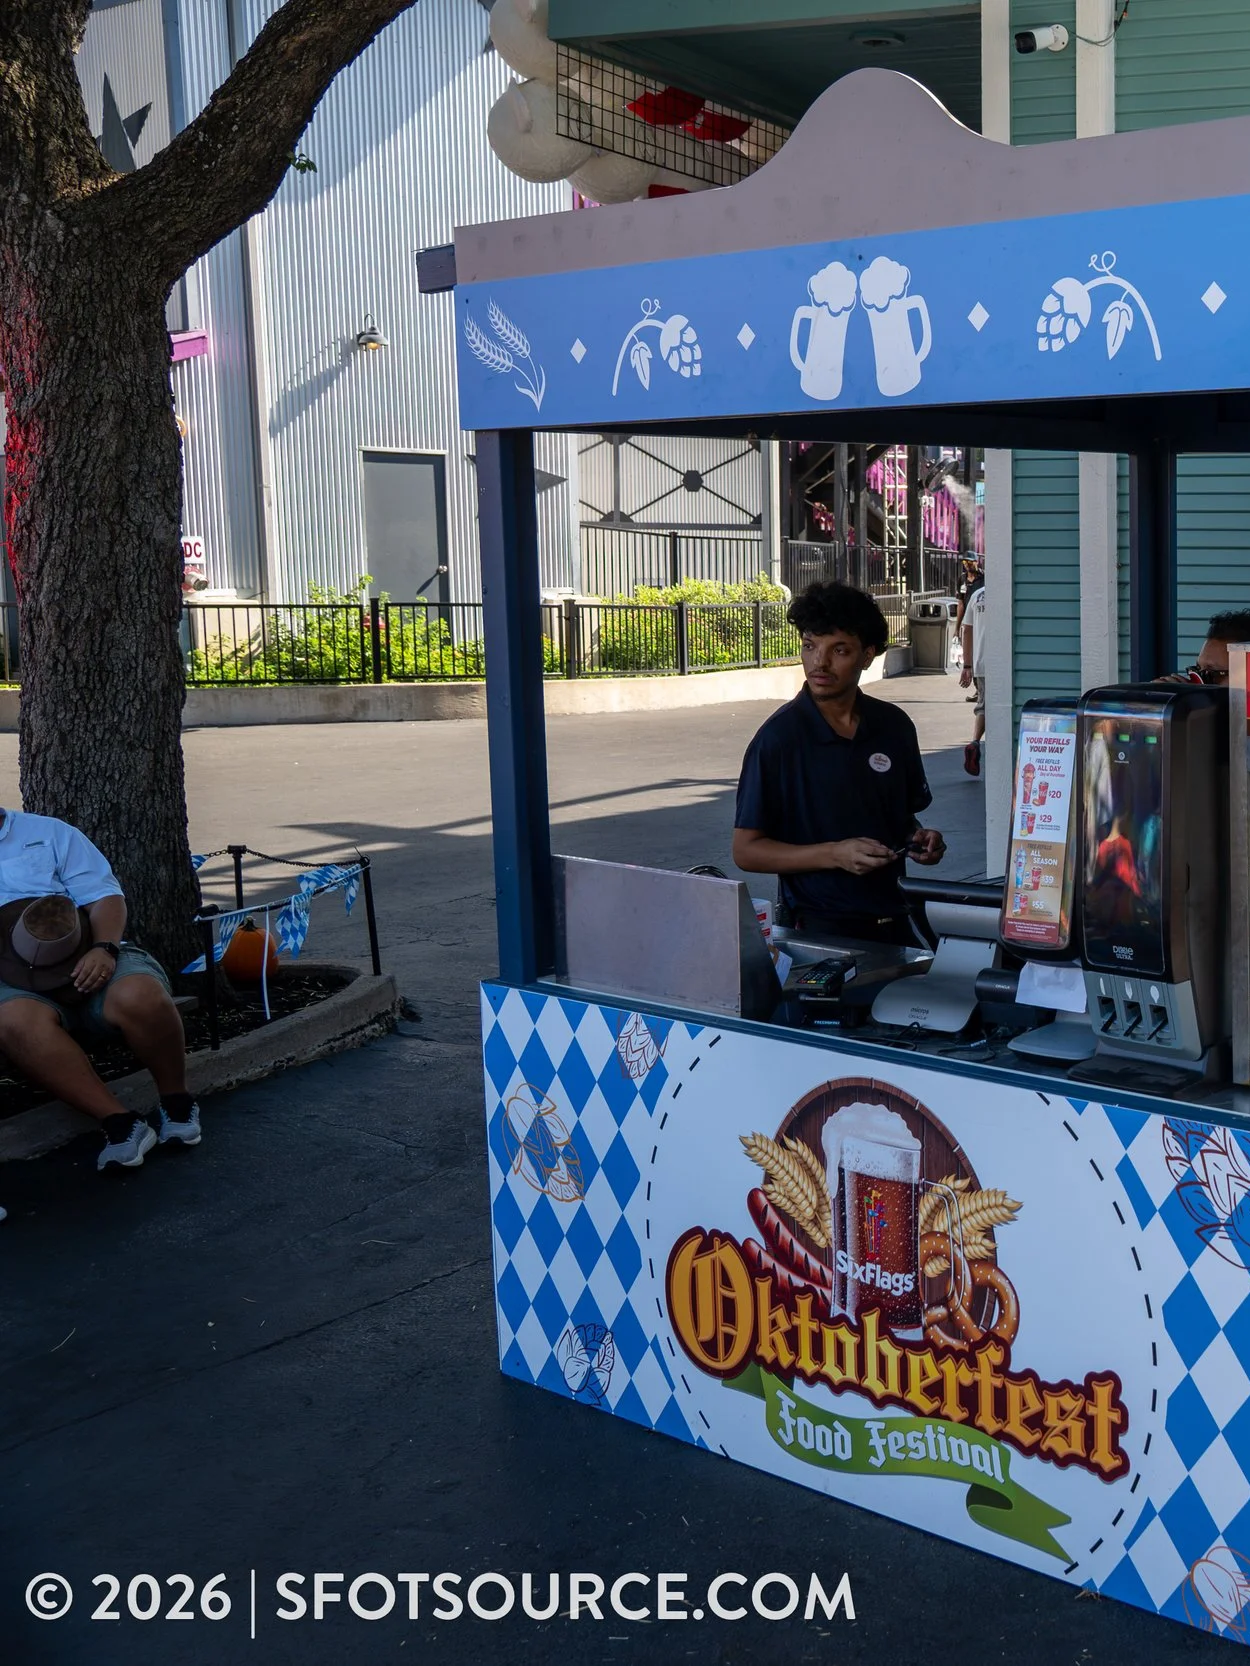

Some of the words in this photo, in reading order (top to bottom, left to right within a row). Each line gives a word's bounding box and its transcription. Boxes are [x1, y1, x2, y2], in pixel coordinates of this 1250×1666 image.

[183, 541, 202, 558] DC
[1026, 736, 1043, 744] YOUR
[1043, 737, 1071, 746] REFILLS
[1029, 745, 1047, 753] YOUR
[1048, 790, 1062, 799] $20
[1039, 814, 1052, 823] $29
[1033, 858, 1058, 866] SEASON
[669, 1230, 1125, 1475] Oktoberfest
[776, 1389, 852, 1462] Food
[863, 1420, 1005, 1484] Festival
